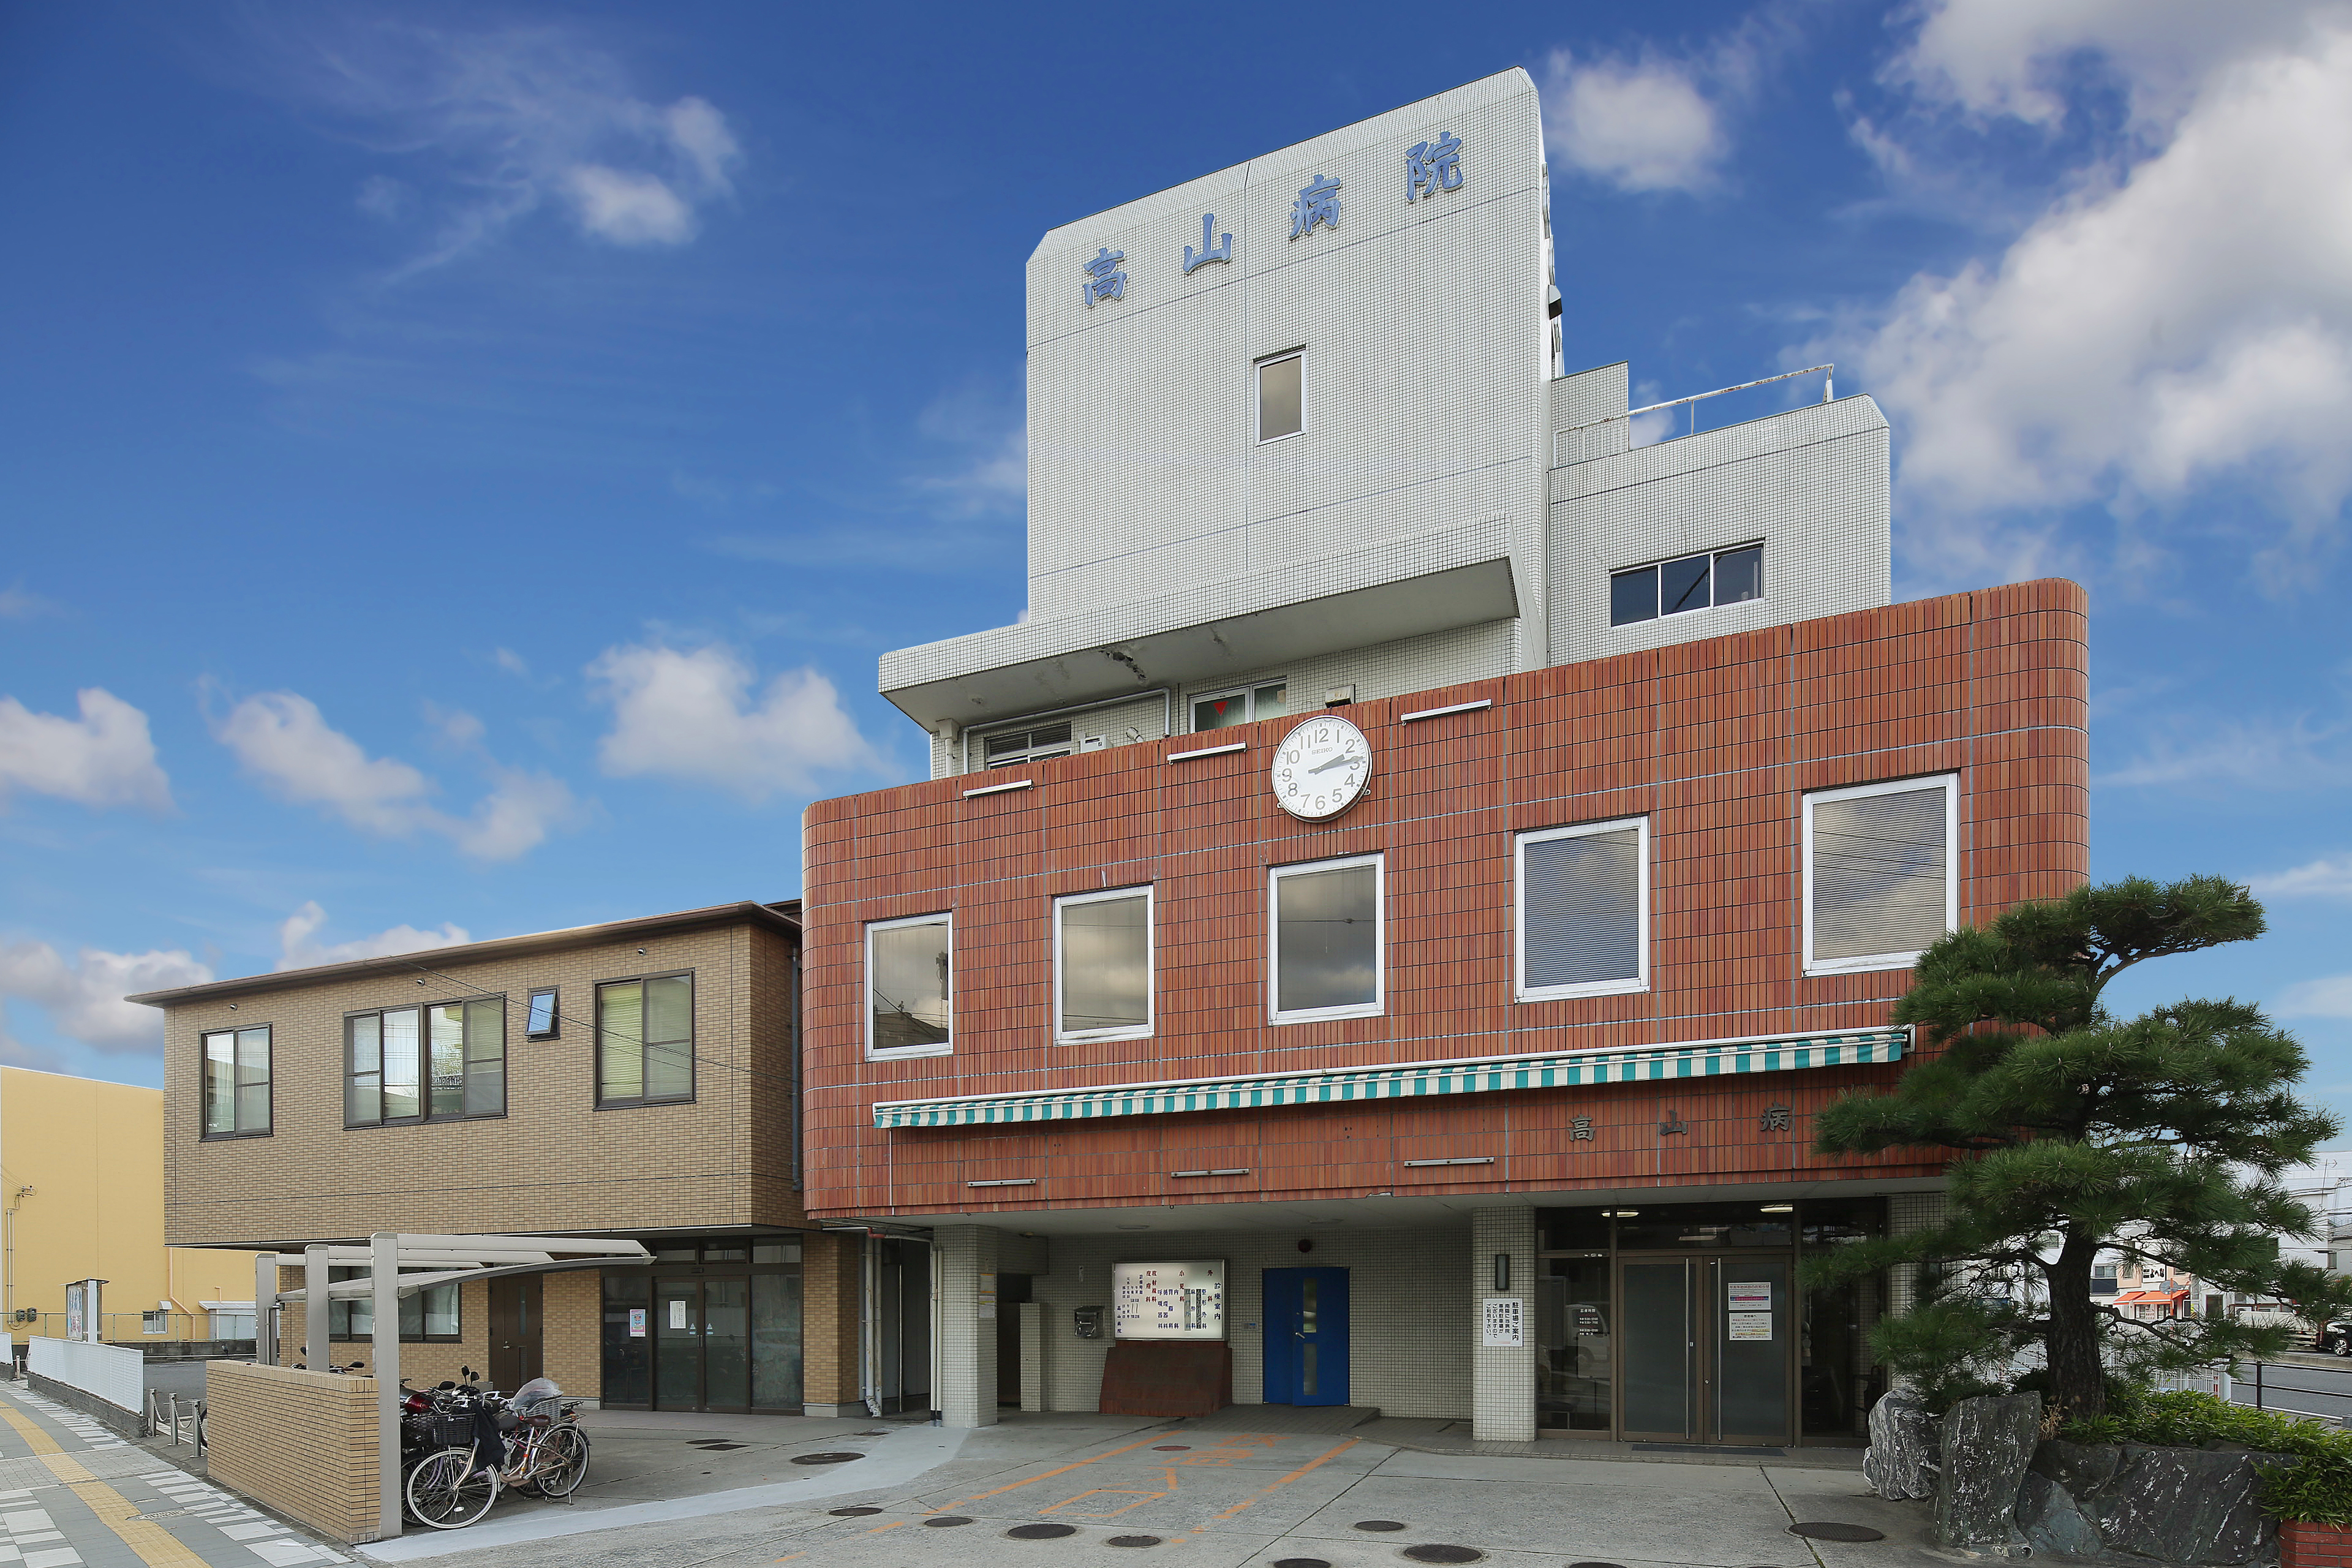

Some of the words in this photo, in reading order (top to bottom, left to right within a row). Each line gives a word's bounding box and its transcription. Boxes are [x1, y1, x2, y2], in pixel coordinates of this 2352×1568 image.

[1082, 131, 1464, 309] 高山病院
[1300, 734, 1311, 750] 11
[1315, 728, 1329, 743] 12
[1345, 739, 1355, 754] 2
[1286, 750, 1300, 765] 10
[1282, 768, 1292, 782] 9
[1344, 774, 1355, 788] 4
[1287, 782, 1298, 797] 8
[1332, 788, 1343, 802] 5
[1300, 794, 1311, 808] 7
[1315, 796, 1325, 810] 6
[1567, 1102, 1791, 1142] 高山病
